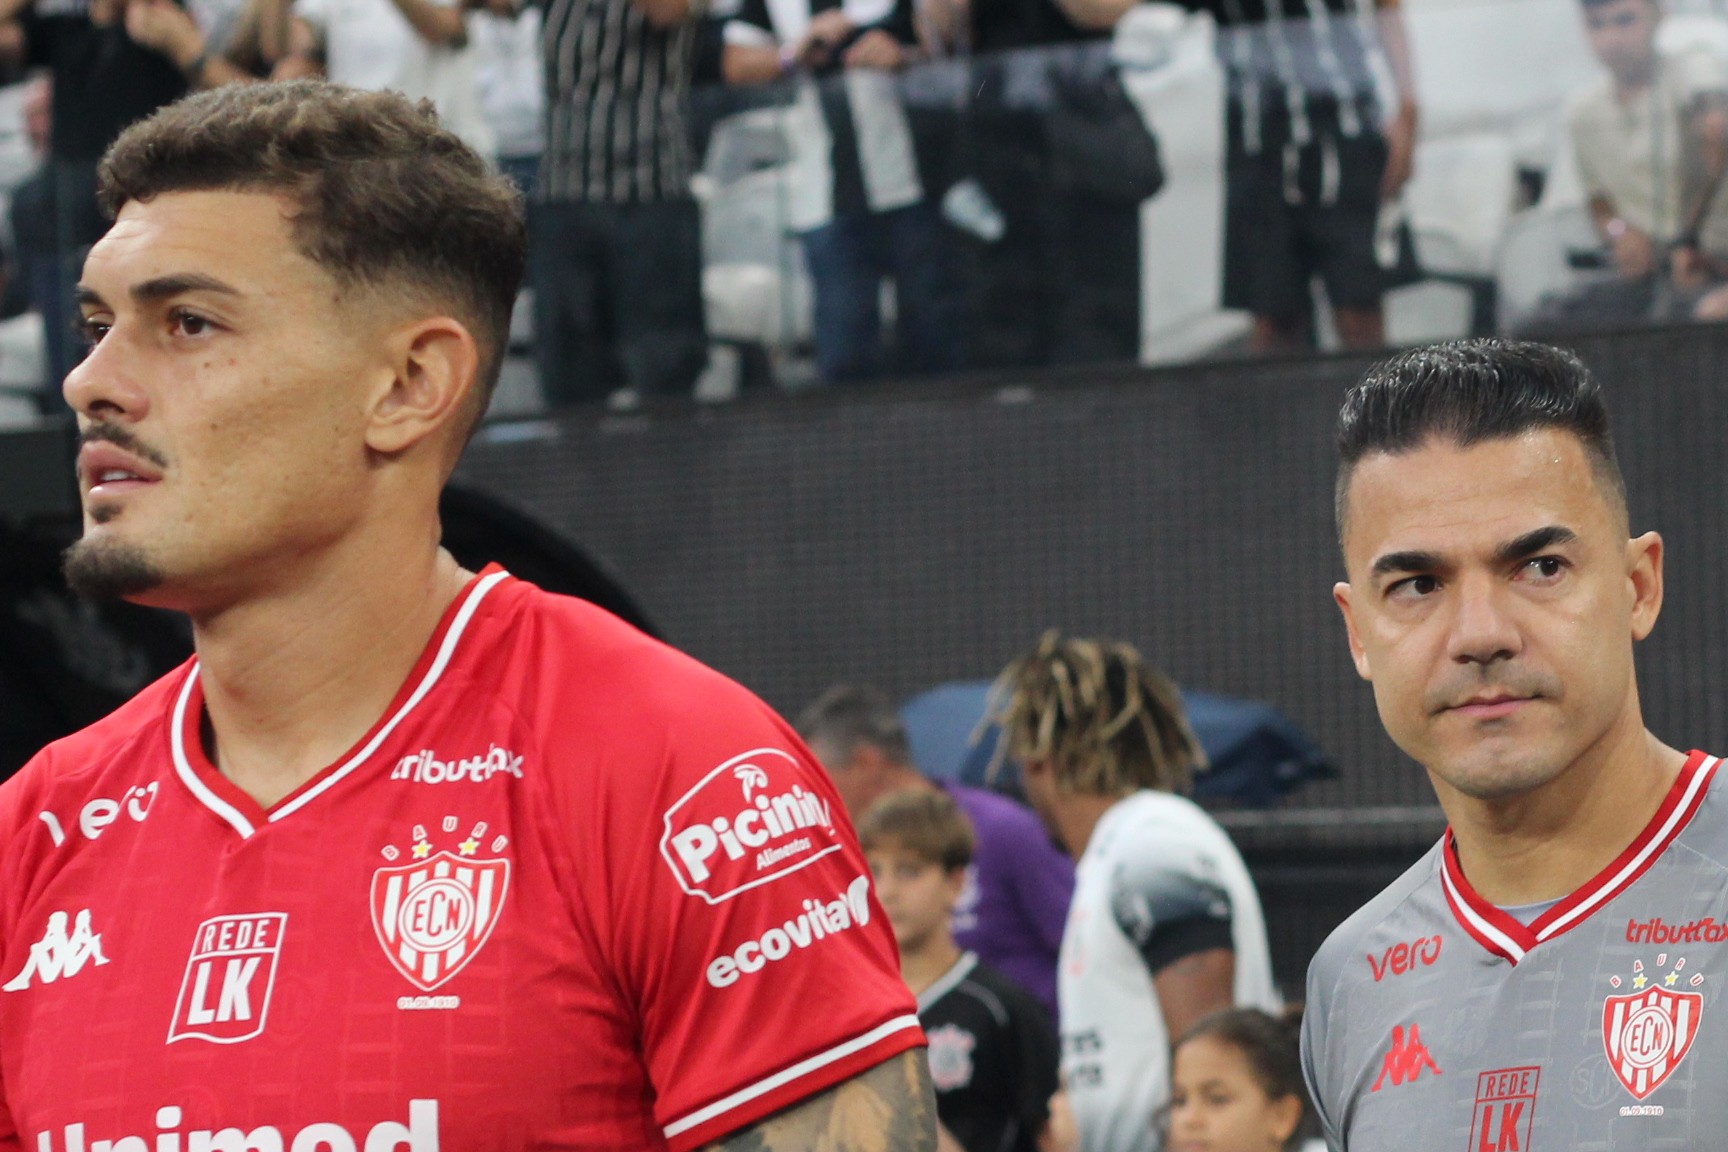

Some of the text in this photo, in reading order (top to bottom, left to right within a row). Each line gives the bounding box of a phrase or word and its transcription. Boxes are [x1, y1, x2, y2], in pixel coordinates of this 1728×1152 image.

[381, 816, 508, 861] BAURU
[756, 837, 811, 870] Alimentos
[412, 890, 461, 937] ECN
[201, 919, 270, 952] REDE
[1366, 934, 1442, 981] vero
[1610, 953, 1704, 988] BAURU
[186, 957, 261, 1025] LK
[1631, 1016, 1663, 1056] ECN
[1485, 1072, 1530, 1098] REDE
